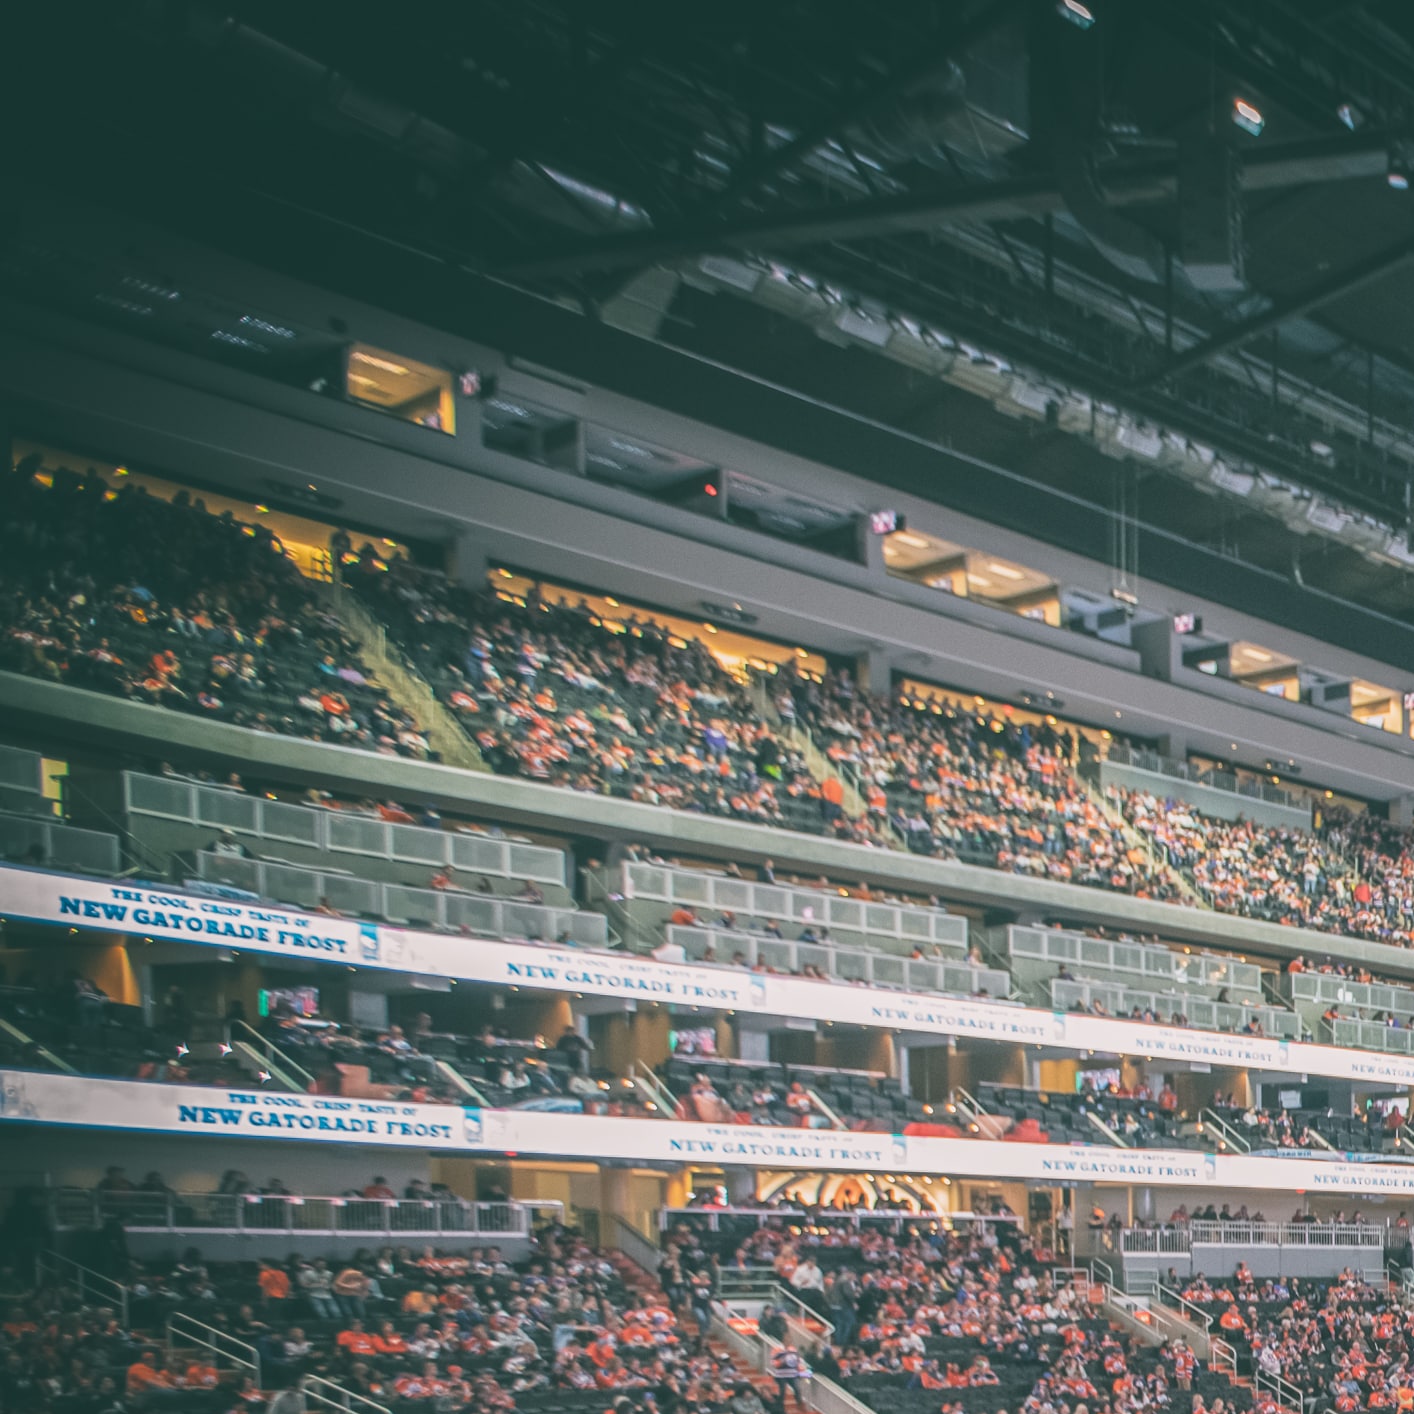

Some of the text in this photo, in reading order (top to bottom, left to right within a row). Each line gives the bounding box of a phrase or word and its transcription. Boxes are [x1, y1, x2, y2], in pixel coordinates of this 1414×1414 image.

[59, 896, 347, 953] NEW GATORADE FROST
[507, 962, 558, 979] NEW
[565, 969, 672, 993] GATORADE
[682, 984, 738, 1000] FROST
[179, 1105, 452, 1138] NEW GATORADE FROST
[669, 1142, 881, 1161] NEW GATORADE FROST
